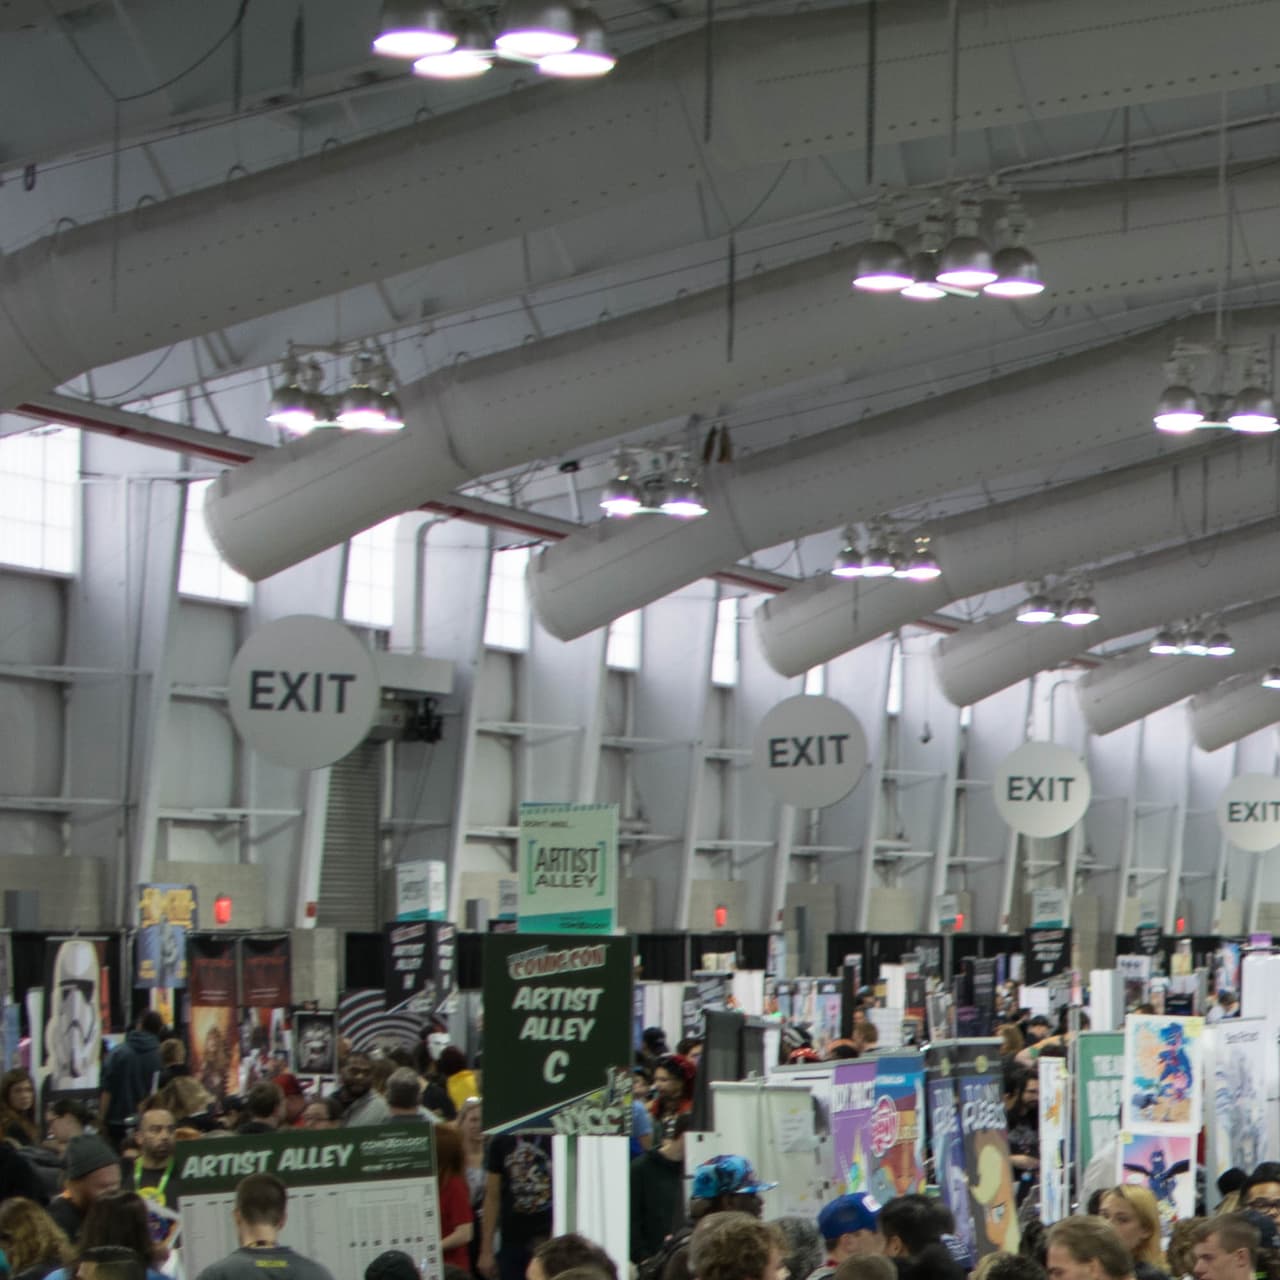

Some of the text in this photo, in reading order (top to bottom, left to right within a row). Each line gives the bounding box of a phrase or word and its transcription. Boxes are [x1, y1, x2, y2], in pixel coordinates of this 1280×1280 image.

[250, 672, 356, 714] EXIT
[770, 735, 849, 768] EXIT
[1007, 777, 1076, 802] EXIT
[535, 848, 600, 872] ARTIST
[535, 874, 599, 888] ALLEY
[512, 952, 566, 978] COMIC
[569, 948, 604, 967] CON
[512, 986, 605, 1012] ARTIST
[518, 1016, 597, 1043] ALLEY
[542, 1049, 571, 1085] C
[181, 1149, 276, 1179] ARTIST
[277, 1143, 355, 1172] ALLEY
